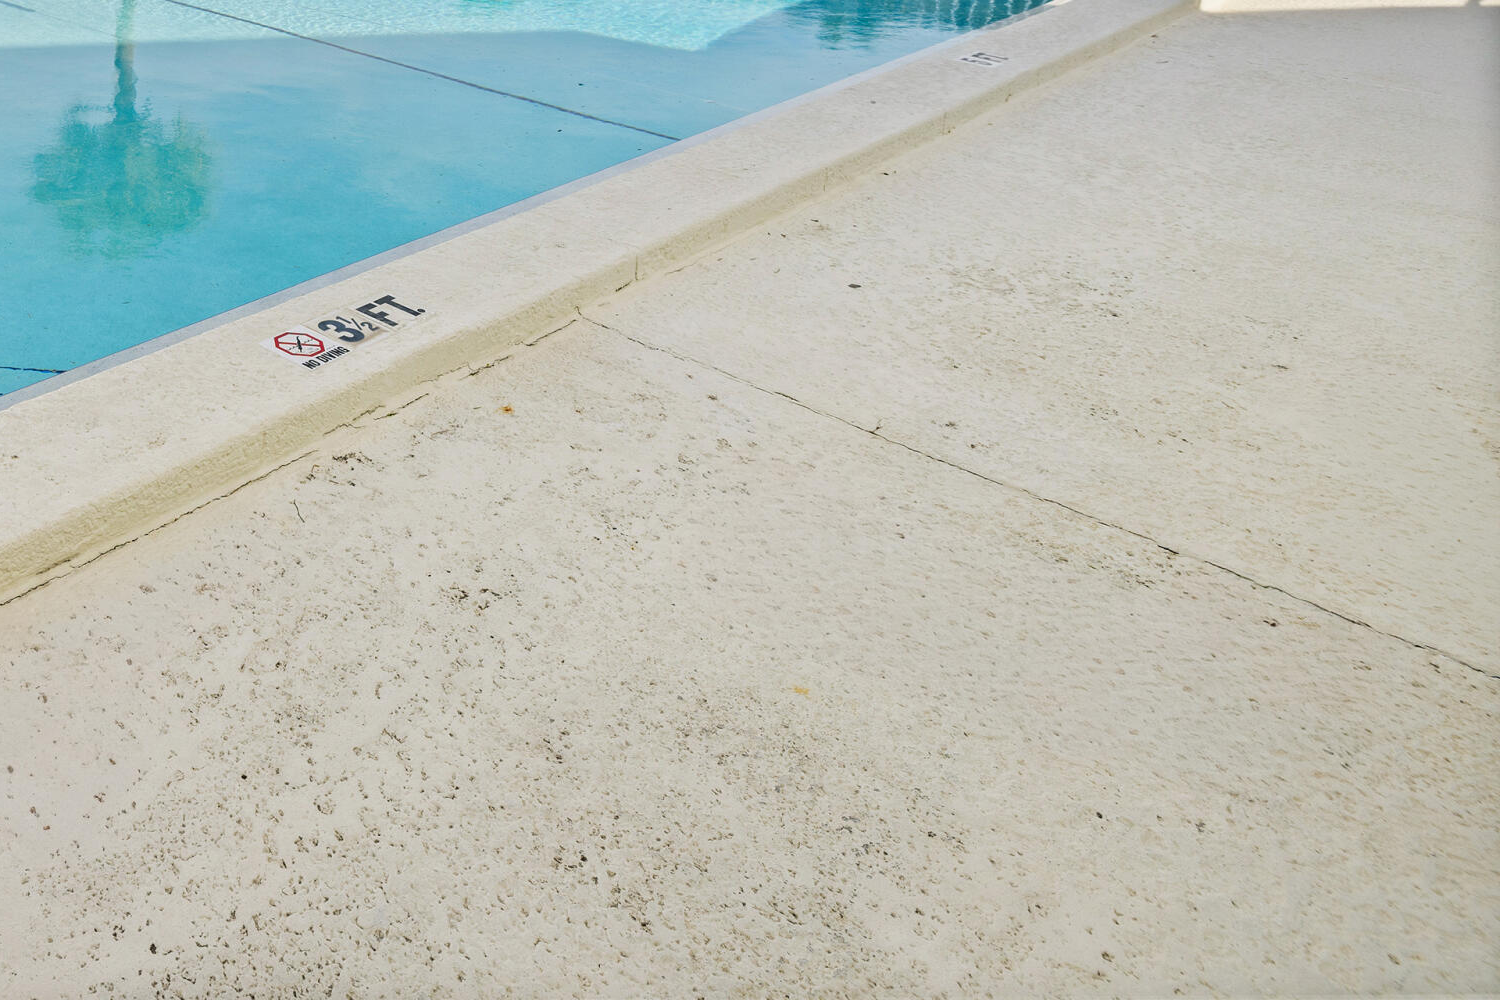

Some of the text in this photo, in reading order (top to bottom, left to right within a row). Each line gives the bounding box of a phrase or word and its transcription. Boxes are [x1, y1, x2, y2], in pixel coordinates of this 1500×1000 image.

[355, 294, 426, 327] FT.
[302, 346, 350, 370] NO DIVING
